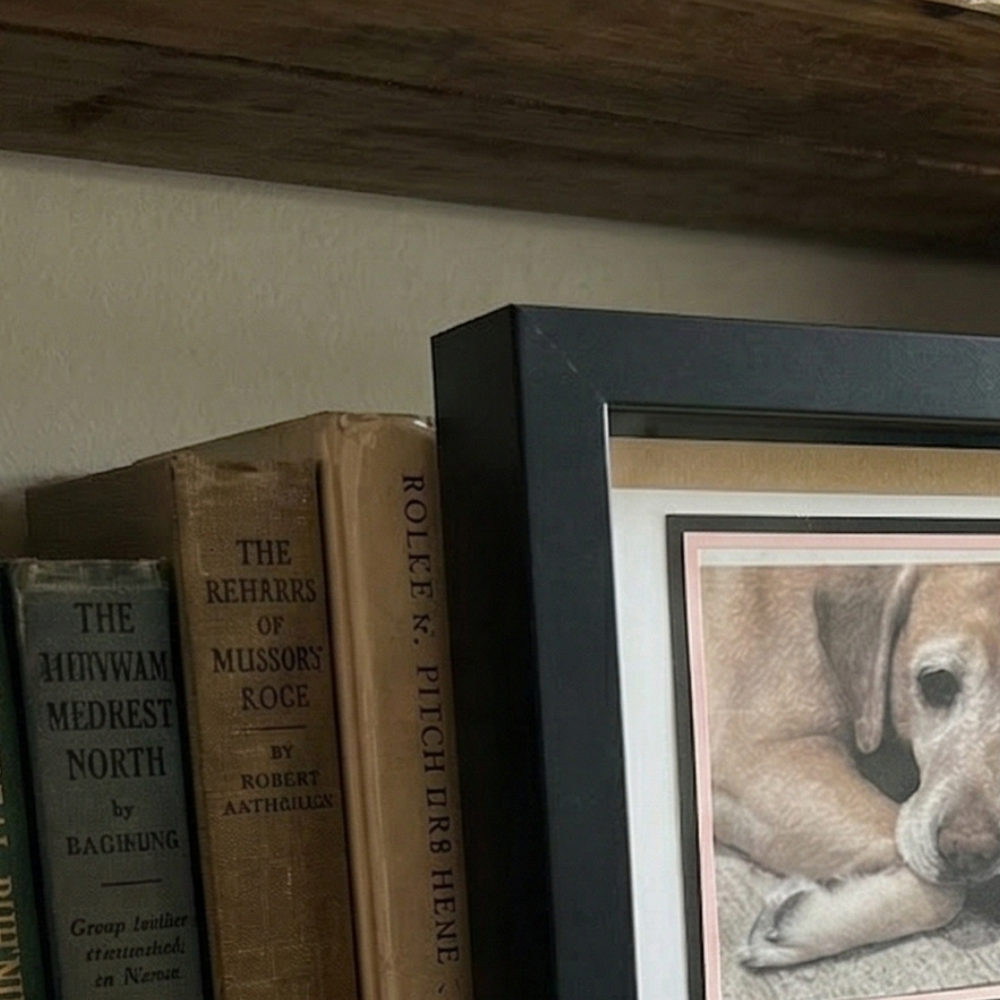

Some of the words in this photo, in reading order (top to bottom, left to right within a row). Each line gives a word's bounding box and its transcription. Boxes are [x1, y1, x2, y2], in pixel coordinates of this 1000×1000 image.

[236, 539, 292, 566] THE
[74, 602, 136, 634] THE
[257, 615, 285, 636] OF
[270, 744, 294, 760] BY
[67, 745, 167, 782] NORTH
[241, 770, 320, 790] ROBERT
[112, 799, 134, 821] by
